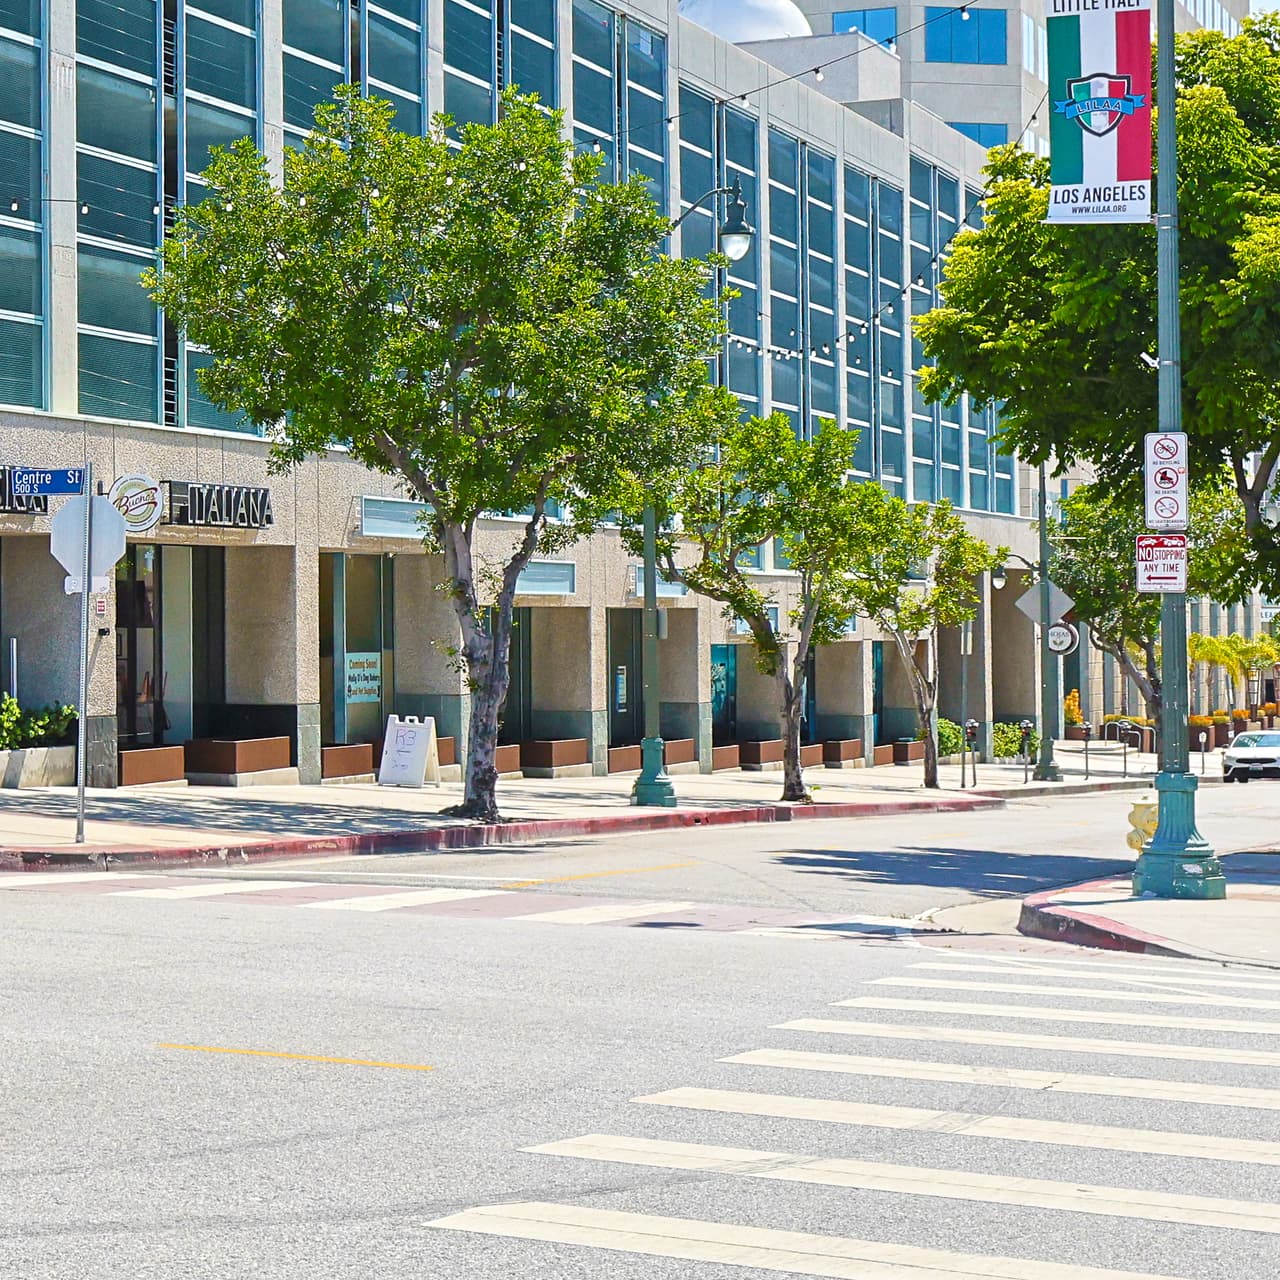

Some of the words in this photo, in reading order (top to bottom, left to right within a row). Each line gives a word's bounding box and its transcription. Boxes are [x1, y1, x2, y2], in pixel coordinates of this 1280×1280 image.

[1076, 100, 1121, 113] LILAA
[1053, 185, 1079, 205] LOS
[1083, 183, 1146, 204] ANGELES
[1071, 204, 1127, 215] WWW.LILAA.ORG
[15, 471, 51, 485] Centre
[67, 471, 79, 484] St
[15, 484, 31, 493] 500
[33, 484, 38, 493] S
[188, 483, 274, 528] ITALIANA
[1139, 547, 1152, 561] NO
[1154, 549, 1185, 560] STOPPING
[1144, 563, 1159, 573] ANY
[1162, 563, 1180, 573] TIME
